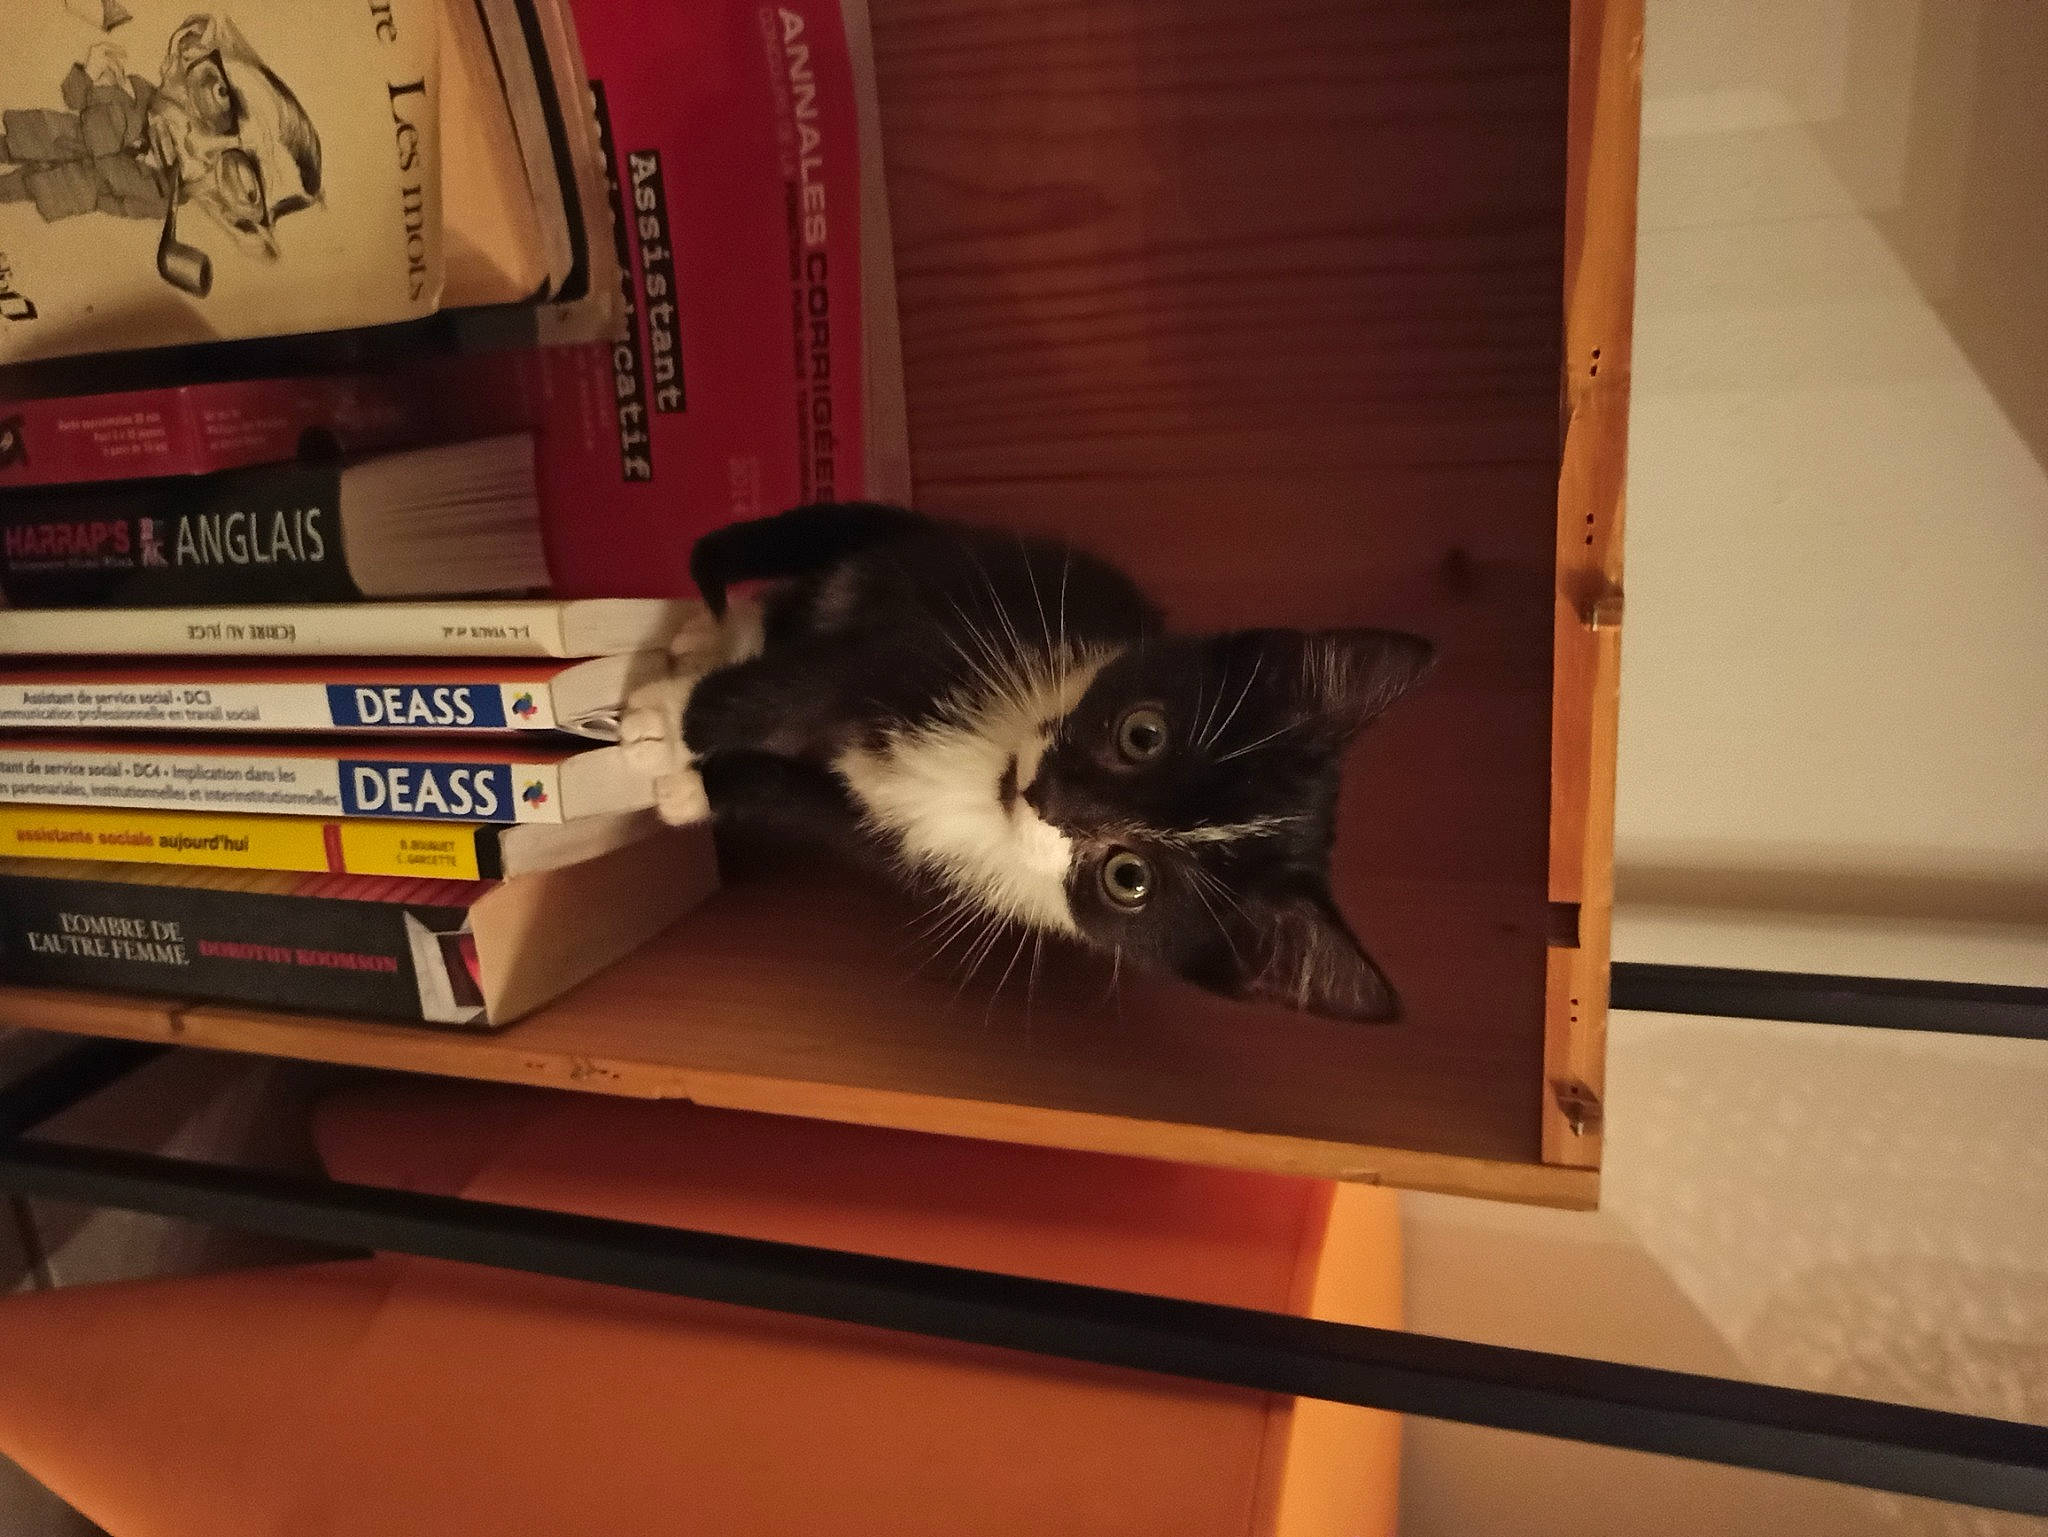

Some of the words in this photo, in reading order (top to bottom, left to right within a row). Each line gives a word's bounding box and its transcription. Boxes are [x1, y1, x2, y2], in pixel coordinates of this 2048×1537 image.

[387, 76, 426, 171] Les
[778, 8, 827, 246] ANNALES
[629, 153, 682, 412] Assistant
[176, 507, 325, 566] ANGLAIS
[23, 692, 75, 704] Assistant
[77, 690, 93, 704] de
[95, 692, 136, 704] service
[139, 690, 173, 704] social
[78, 706, 166, 721] professionnelle
[226, 706, 260, 721] social
[355, 687, 475, 725] DEASS
[25, 760, 41, 774] de
[44, 763, 85, 776] service
[88, 761, 122, 777] social
[172, 764, 243, 784] Implication
[245, 766, 275, 782] dans
[278, 766, 296, 783] les
[354, 766, 498, 816] DEASS
[98, 832, 153, 847] sociale
[159, 834, 249, 852] aujourd'hui
[150, 920, 184, 942] DE
